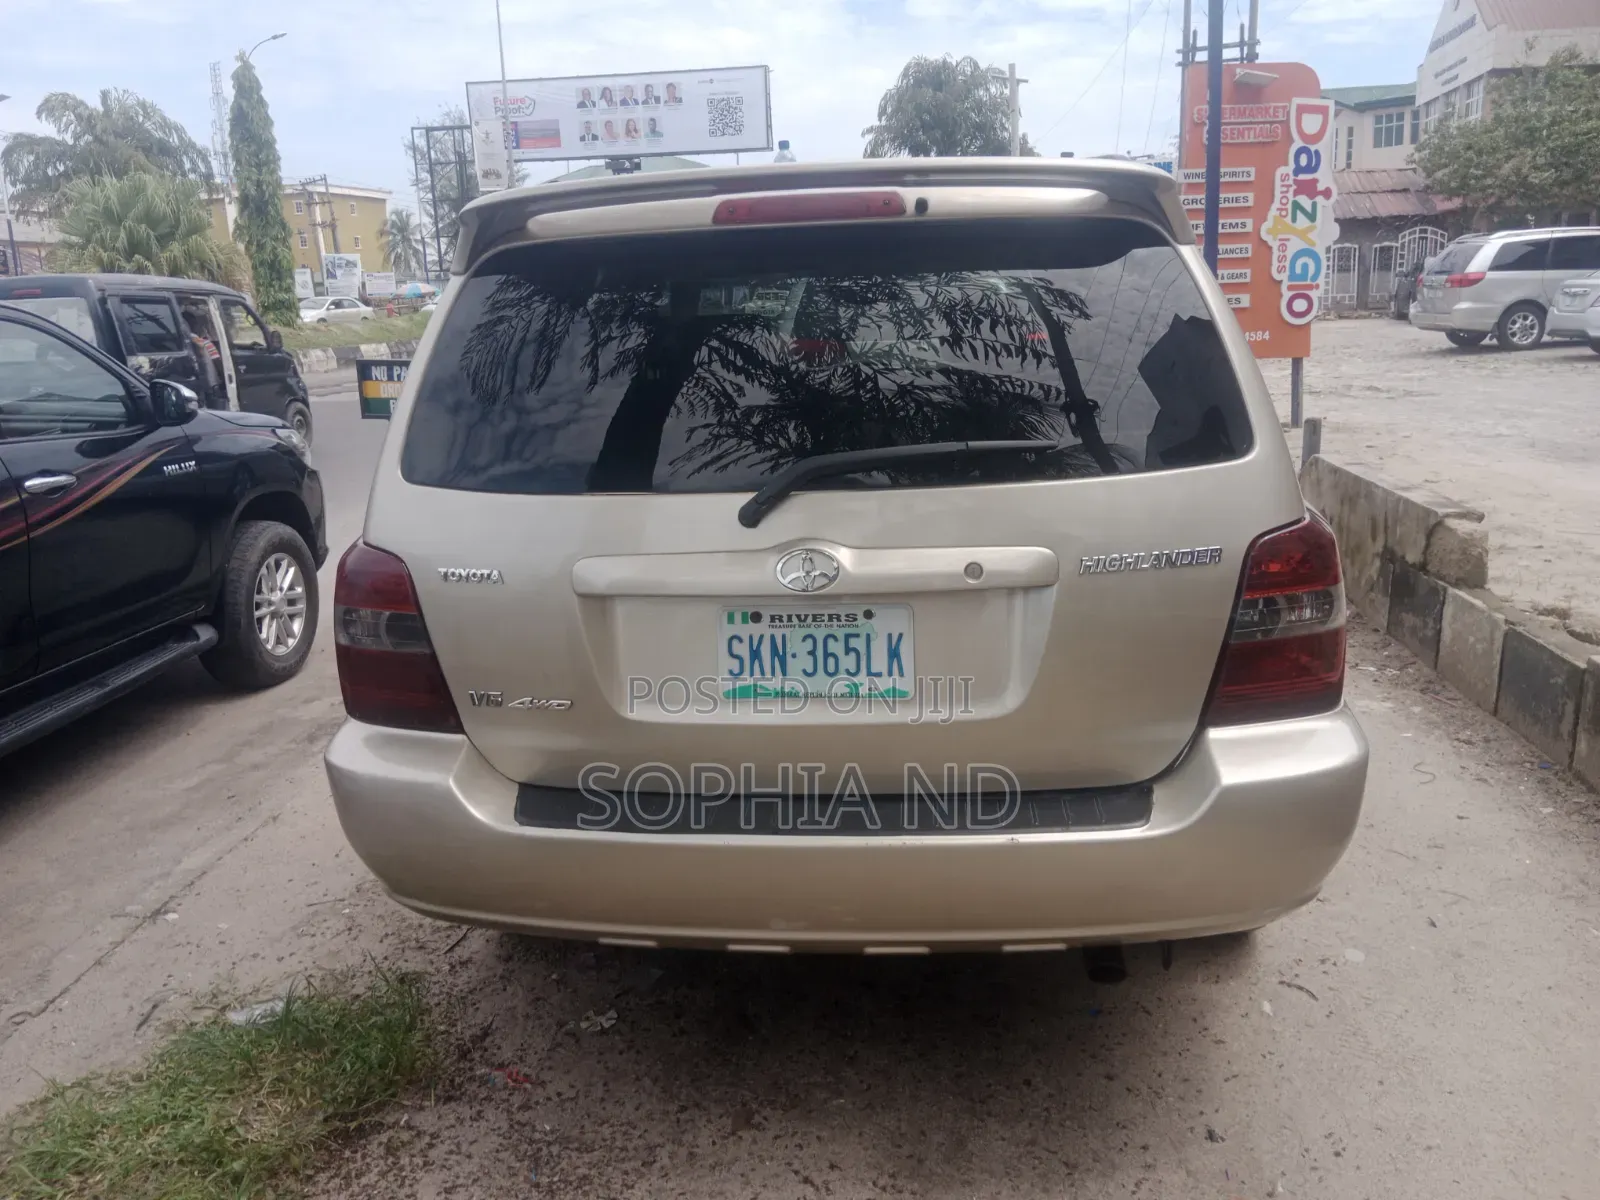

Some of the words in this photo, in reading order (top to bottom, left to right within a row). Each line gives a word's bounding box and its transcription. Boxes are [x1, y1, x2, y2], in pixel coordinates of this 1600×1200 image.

[493, 97, 526, 106] Fuure
[1194, 104, 1288, 123] SERMARKET
[1205, 125, 1280, 141] SENTIALS
[1182, 195, 1249, 206] GROERIES
[1276, 173, 1293, 219] shop
[1217, 221, 1247, 230] EMS
[1217, 247, 1249, 256] LIANCES
[1276, 238, 1291, 275] less
[1226, 271, 1248, 280] GEARS
[371, 365, 388, 381] NO
[163, 460, 197, 476] HILUX
[1079, 545, 1222, 575] HIGHLANDER
[438, 567, 504, 584] TOYOTA
[769, 613, 858, 623] RIVERS
[468, 690, 503, 707] V6
